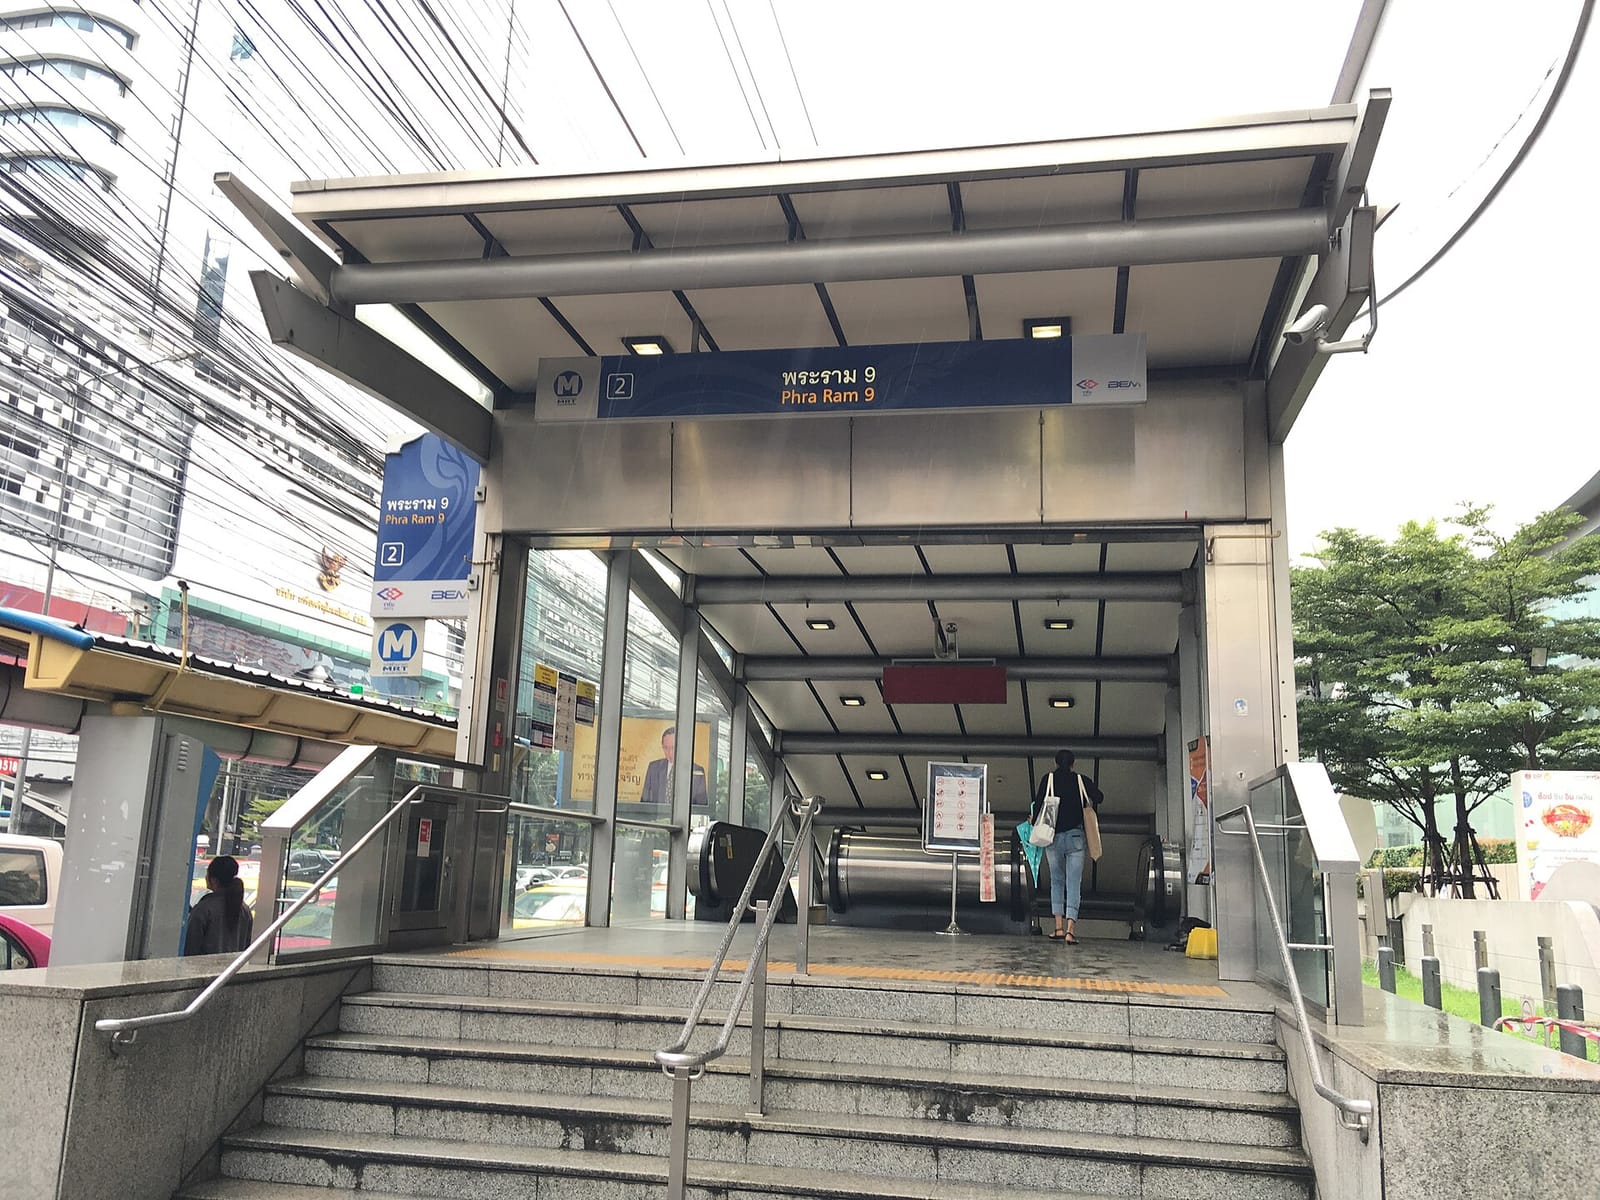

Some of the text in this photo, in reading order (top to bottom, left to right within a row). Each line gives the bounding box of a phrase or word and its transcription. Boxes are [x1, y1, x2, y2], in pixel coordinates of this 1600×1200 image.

[782, 366, 876, 386] พระราม 9
[614, 377, 626, 395] 2
[781, 387, 875, 405] Phra Ram 9
[386, 497, 449, 511] พระราม 9
[385, 512, 445, 525] Phra Ram 9
[387, 546, 397, 562] 2
